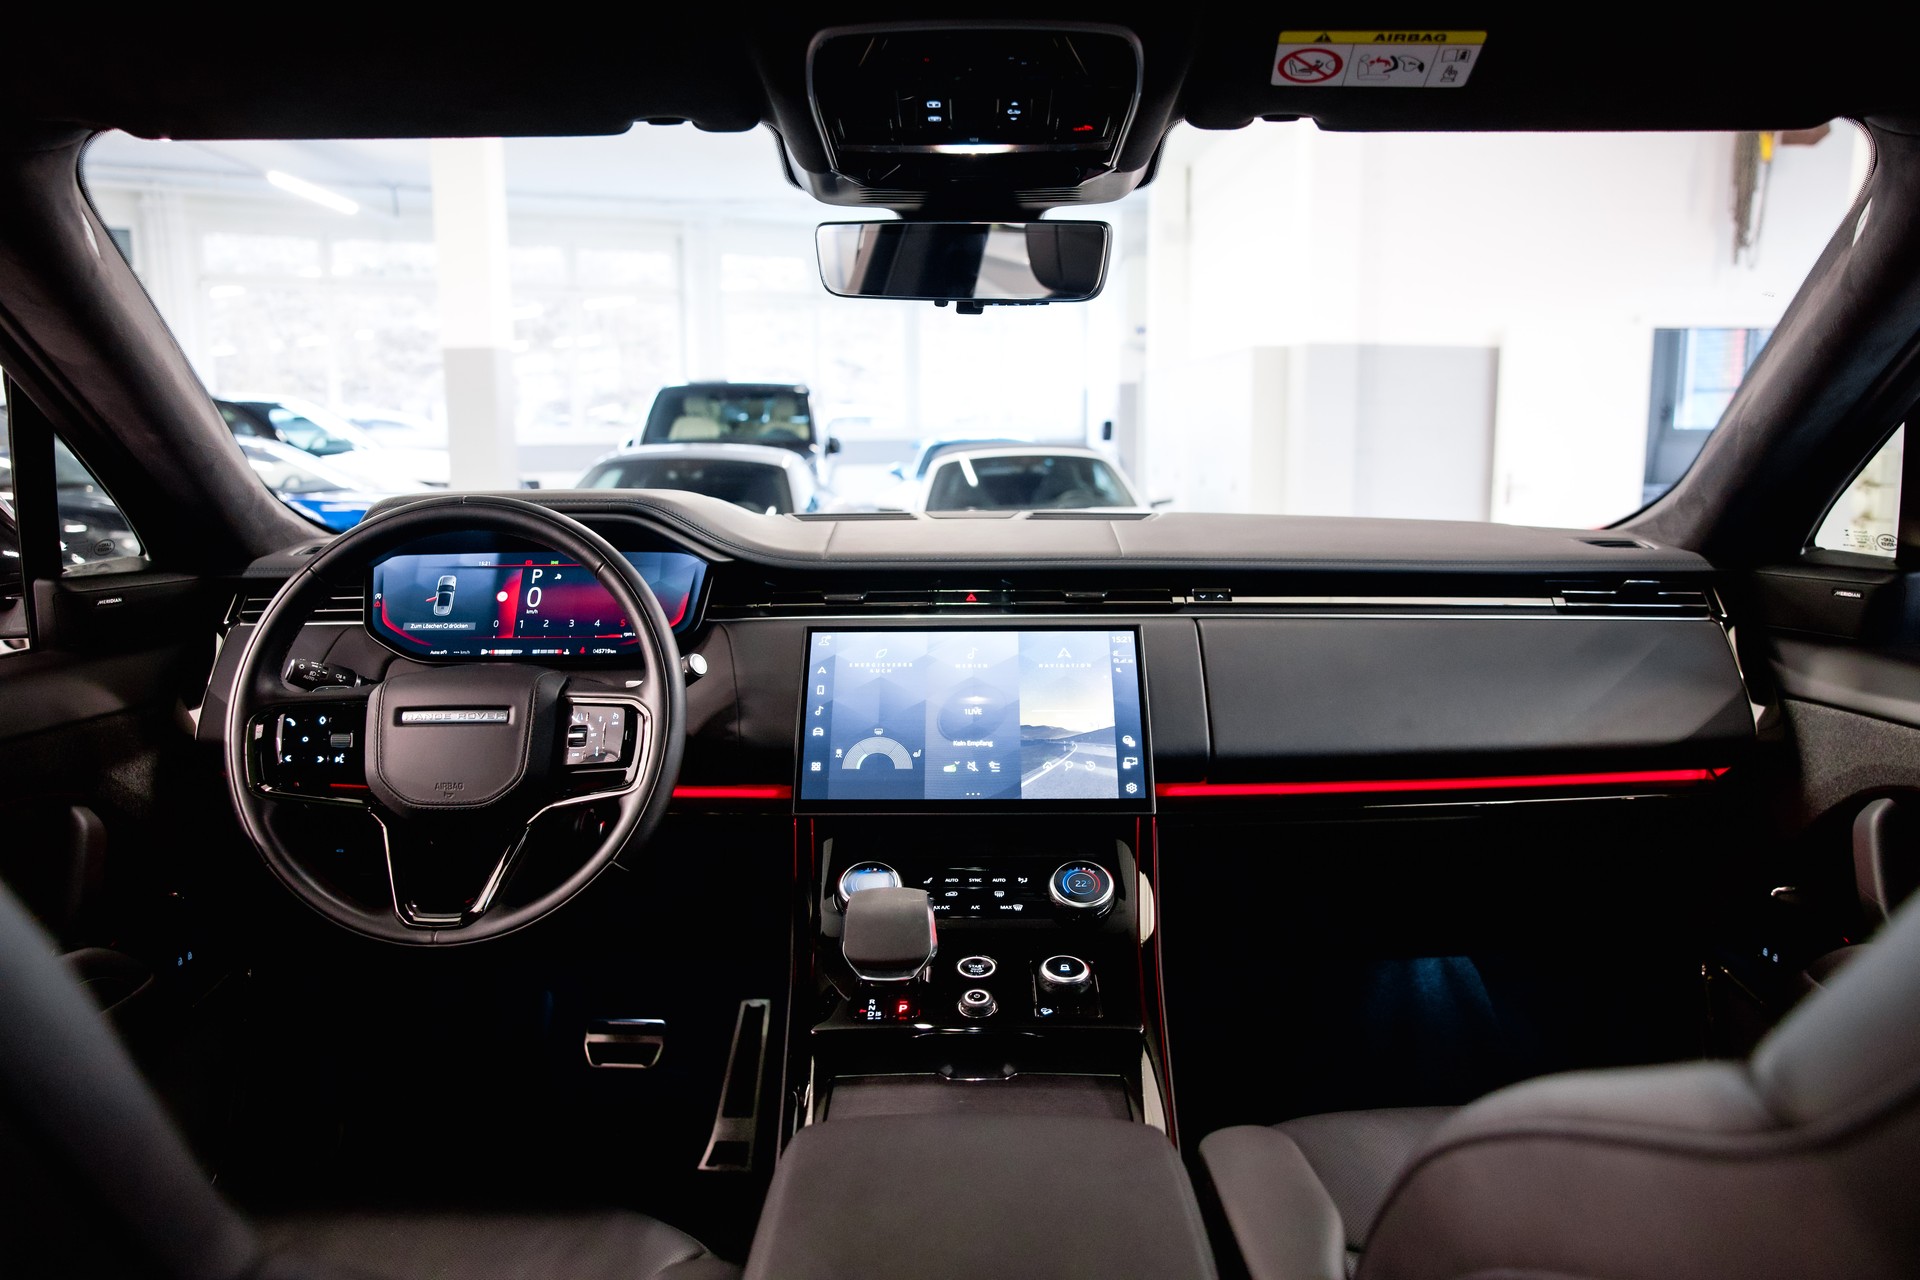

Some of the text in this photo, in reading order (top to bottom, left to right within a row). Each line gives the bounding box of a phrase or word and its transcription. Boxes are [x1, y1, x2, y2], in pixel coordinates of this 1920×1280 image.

[1373, 33, 1447, 42] AIRBAG
[531, 568, 543, 584] P
[526, 586, 542, 608] 0
[1833, 590, 1861, 599] MERIDIAN
[97, 597, 122, 606] MERIDIAN
[543, 619, 549, 628] 2
[568, 619, 575, 628] 3
[594, 619, 601, 628] 4
[456, 711, 506, 721] ROVER
[434, 782, 465, 791] AIRBAG
[898, 1004, 908, 1013] P
